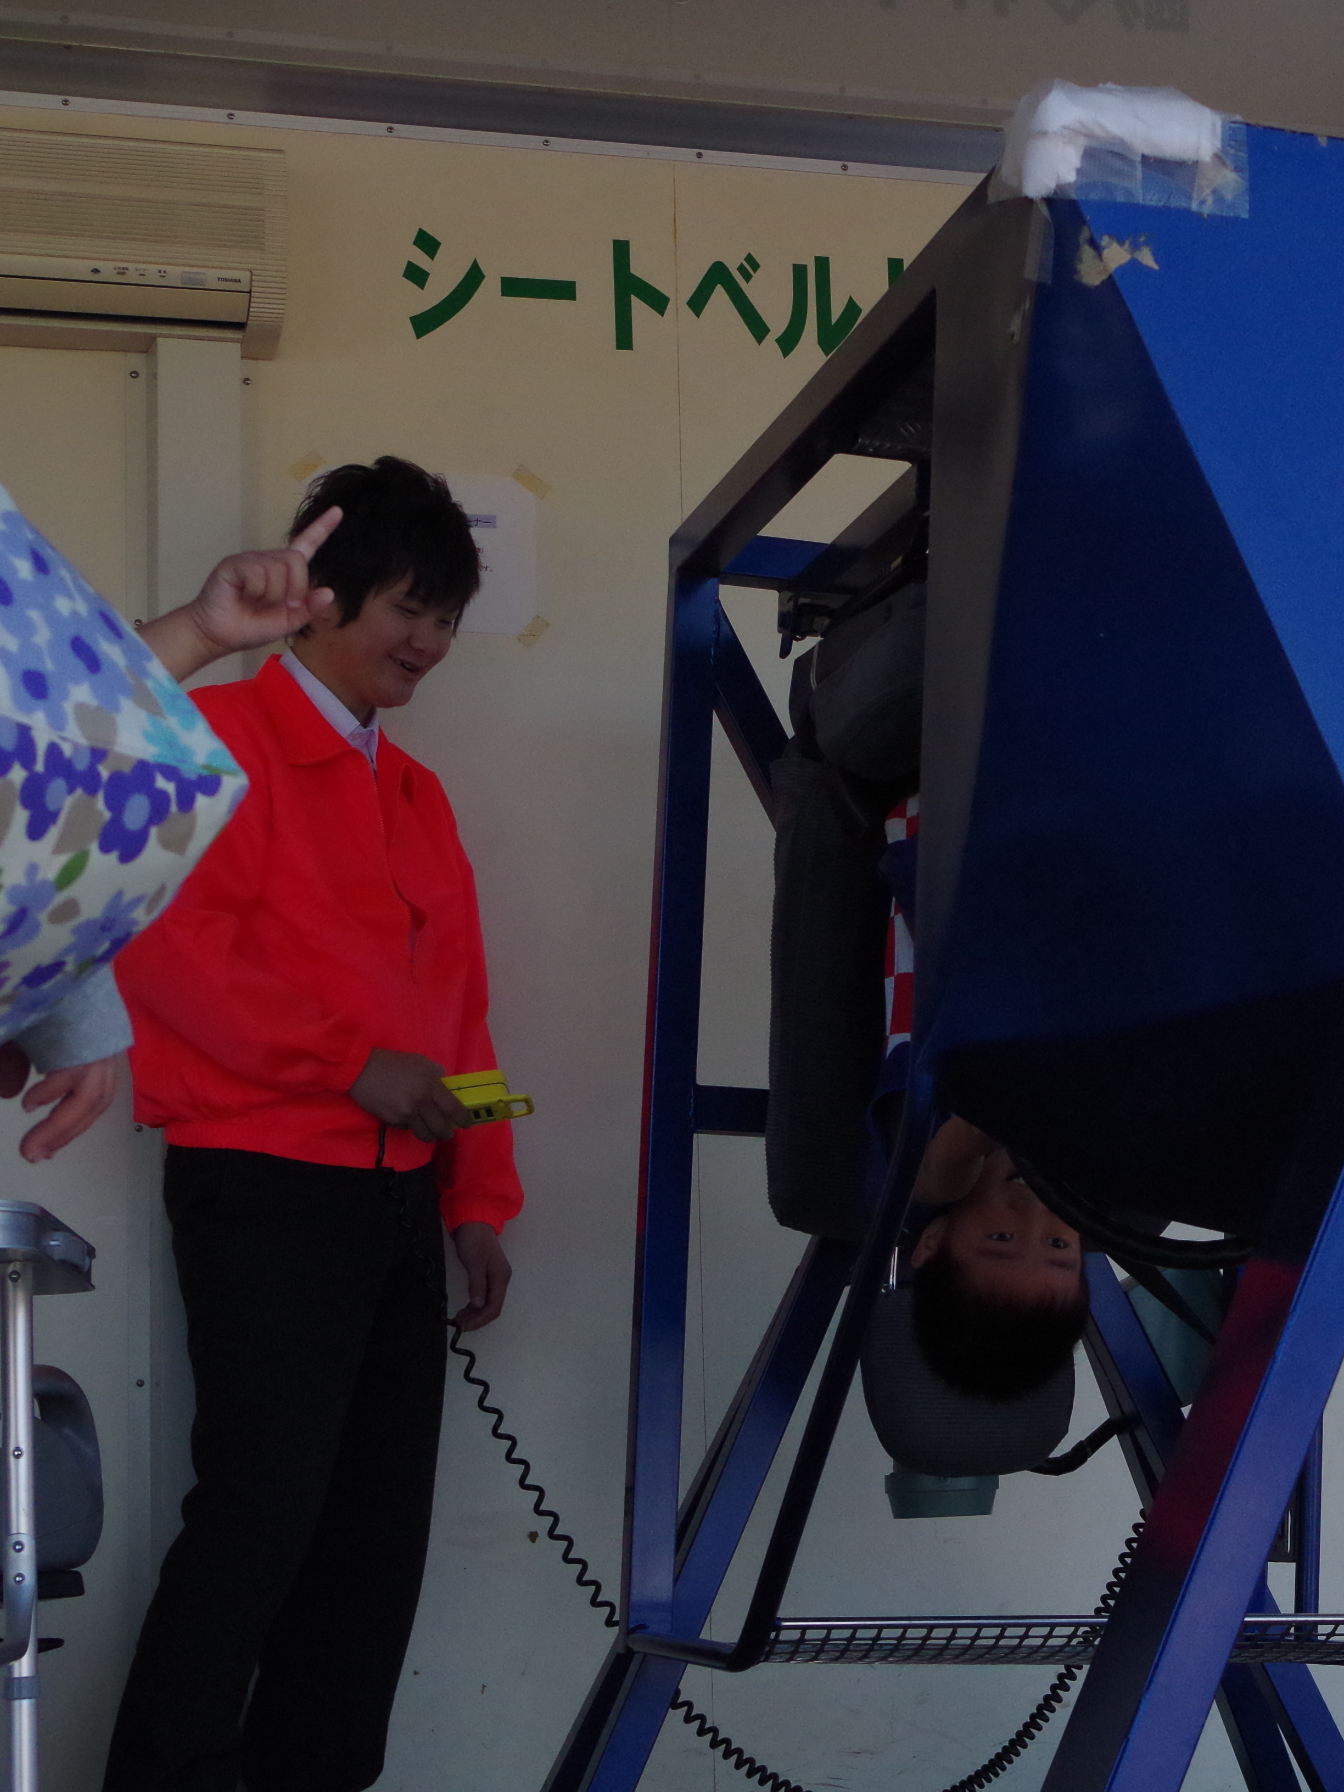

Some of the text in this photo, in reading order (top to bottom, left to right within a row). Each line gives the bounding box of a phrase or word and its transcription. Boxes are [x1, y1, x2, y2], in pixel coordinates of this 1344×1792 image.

[402, 227, 904, 359] シートベル
